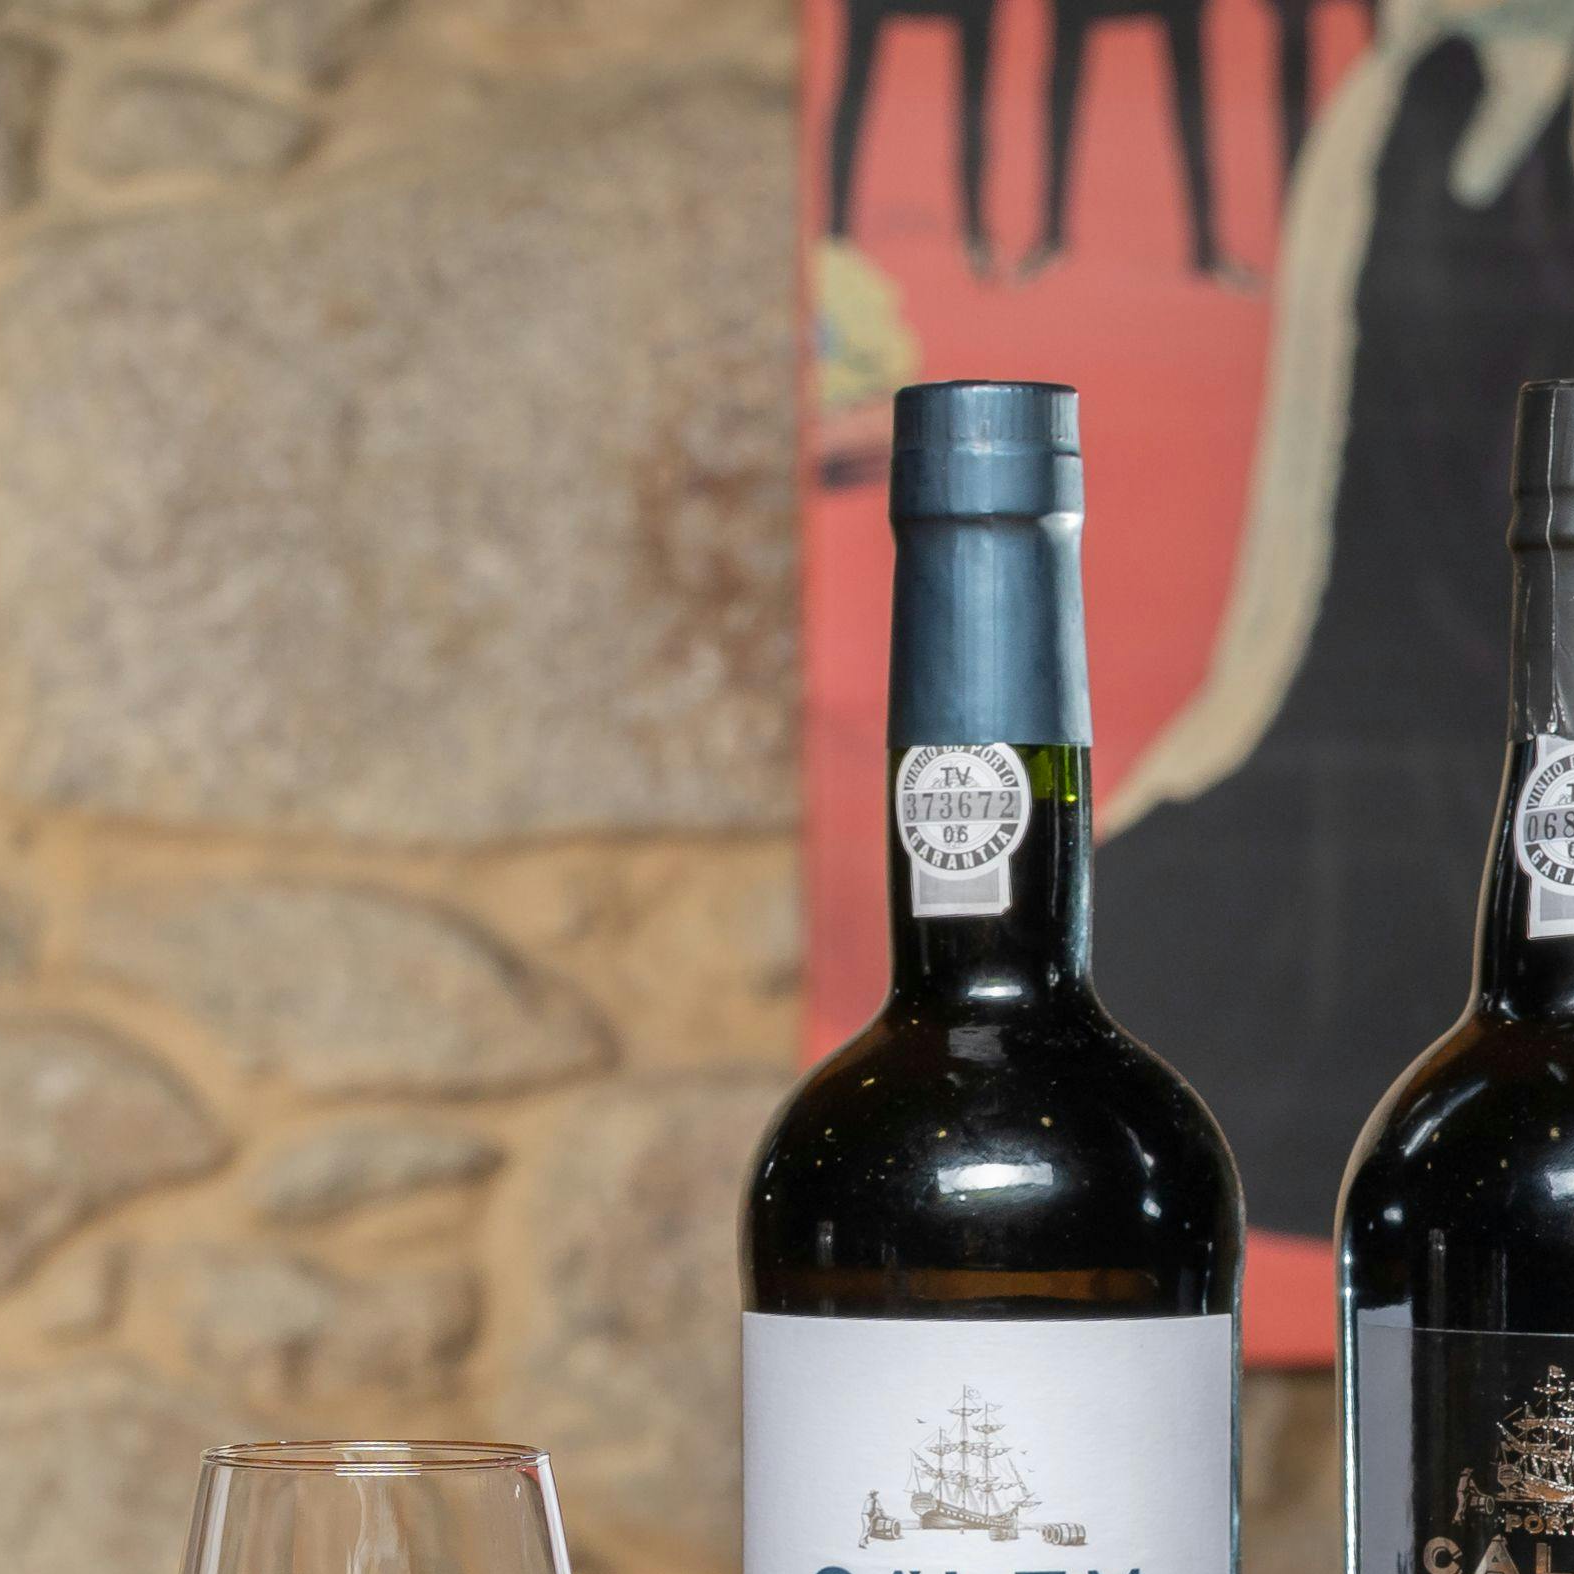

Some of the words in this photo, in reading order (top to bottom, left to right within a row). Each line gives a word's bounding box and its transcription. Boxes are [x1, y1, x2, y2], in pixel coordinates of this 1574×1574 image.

[905, 745, 938, 790] VINHO
[970, 745, 1017, 787] PORTO
[940, 766, 971, 787] TV
[1527, 763, 1565, 809] VINHO
[906, 791, 1015, 820] 373672
[910, 830, 1013, 871] GARANTIA
[943, 825, 968, 843] 06
